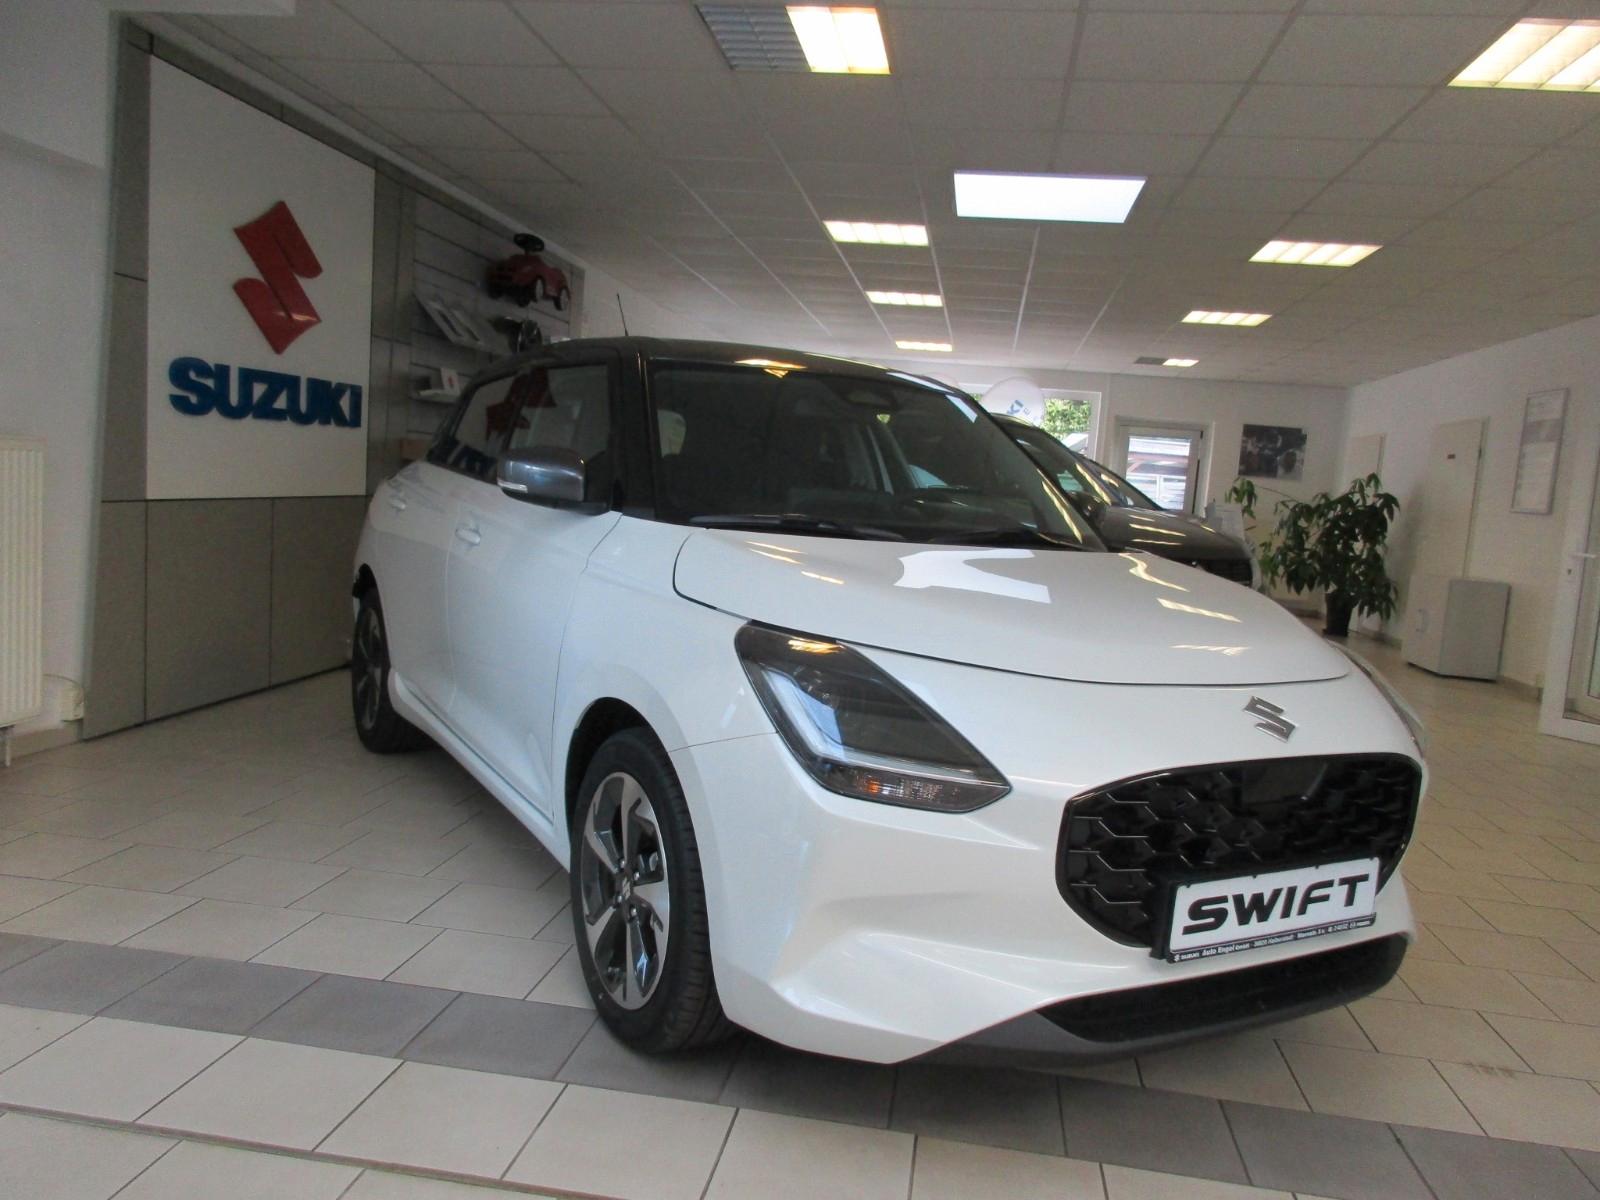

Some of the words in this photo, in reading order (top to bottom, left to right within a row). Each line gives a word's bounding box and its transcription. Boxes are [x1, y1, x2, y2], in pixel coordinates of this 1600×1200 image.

[169, 356, 362, 428] SUZUKI
[1182, 873, 1369, 935] SWIFT
[1202, 948, 1217, 957] Auto
